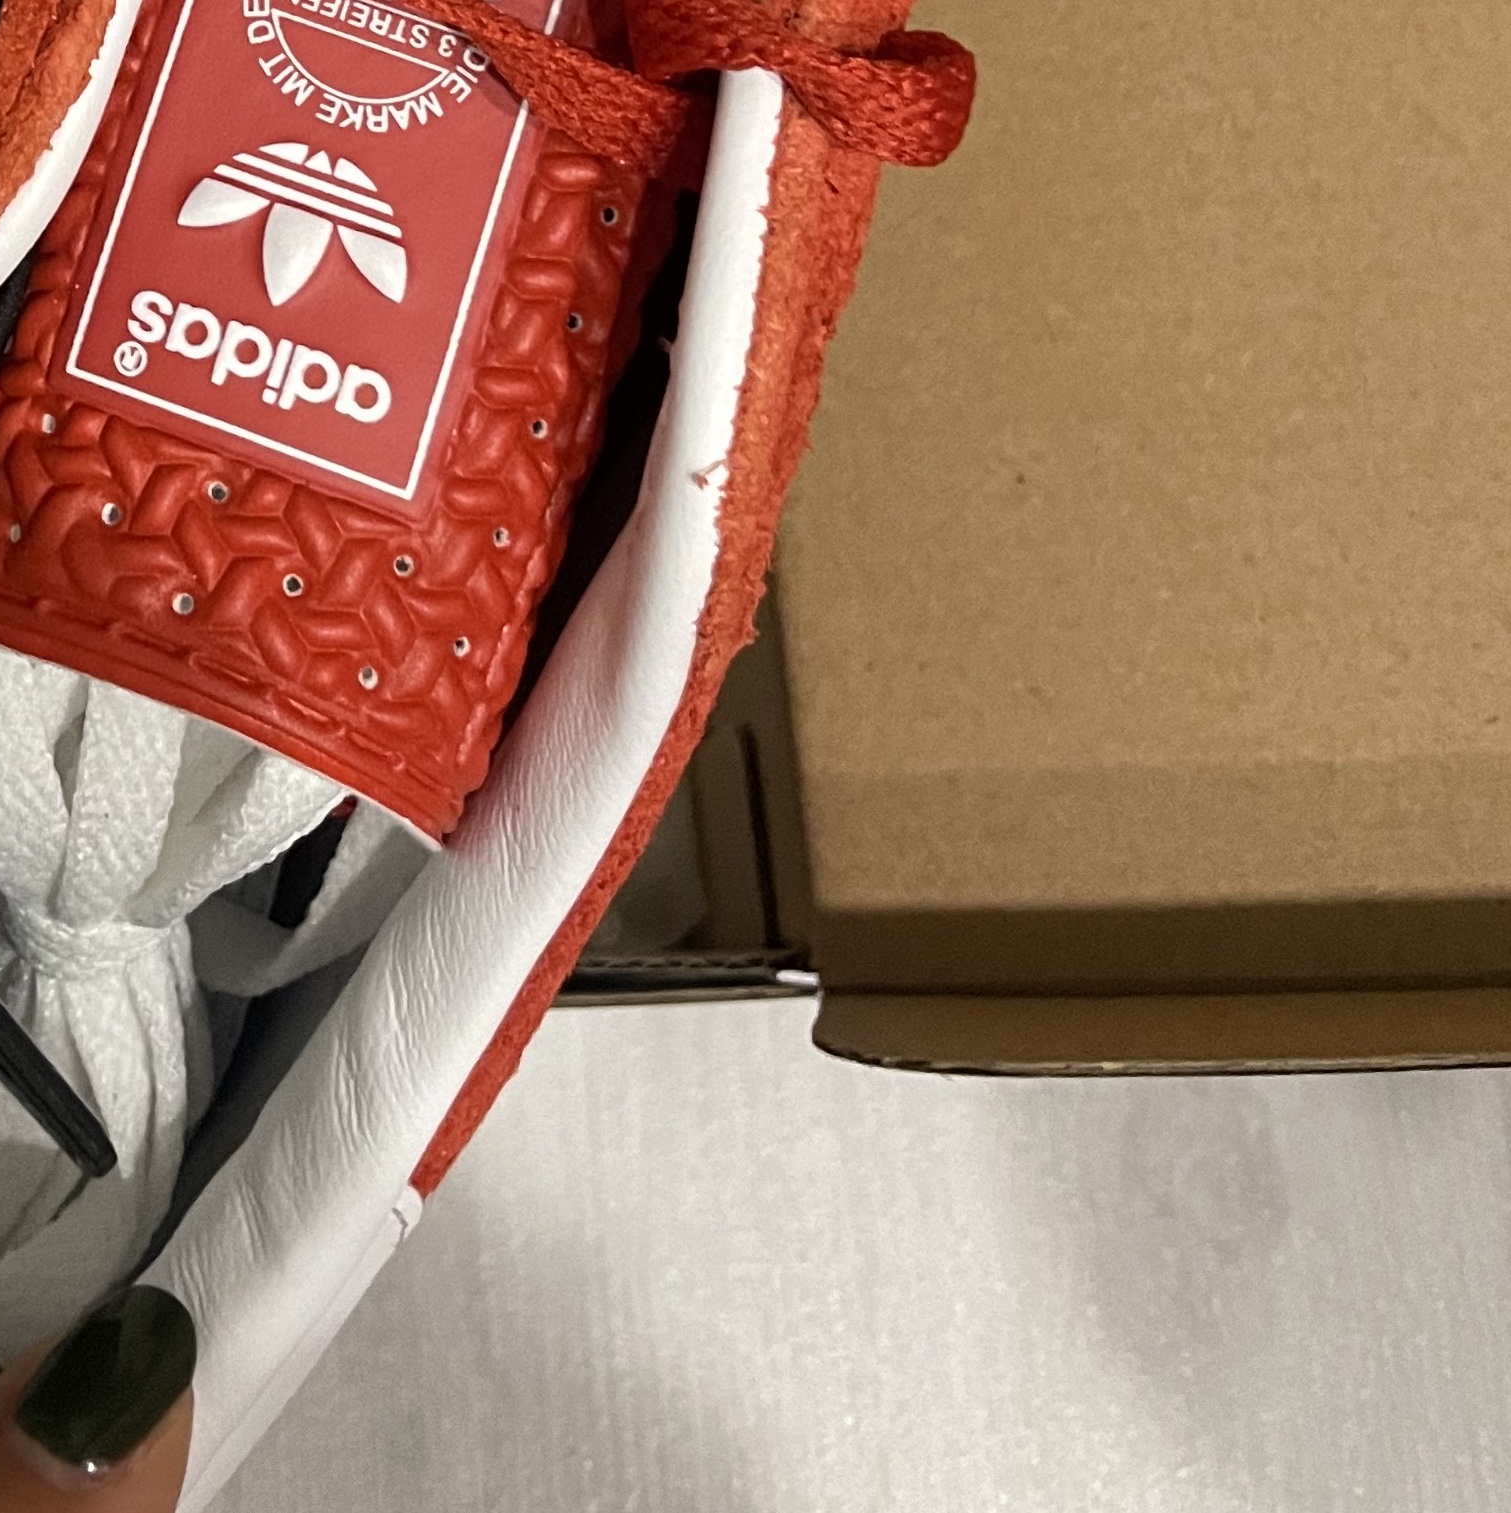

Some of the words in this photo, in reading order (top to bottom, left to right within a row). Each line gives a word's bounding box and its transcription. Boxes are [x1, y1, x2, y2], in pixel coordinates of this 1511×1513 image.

[436, 32, 457, 58] 3
[258, 51, 316, 107] MIT
[440, 43, 491, 103] DIE
[314, 91, 444, 133] MARKE
